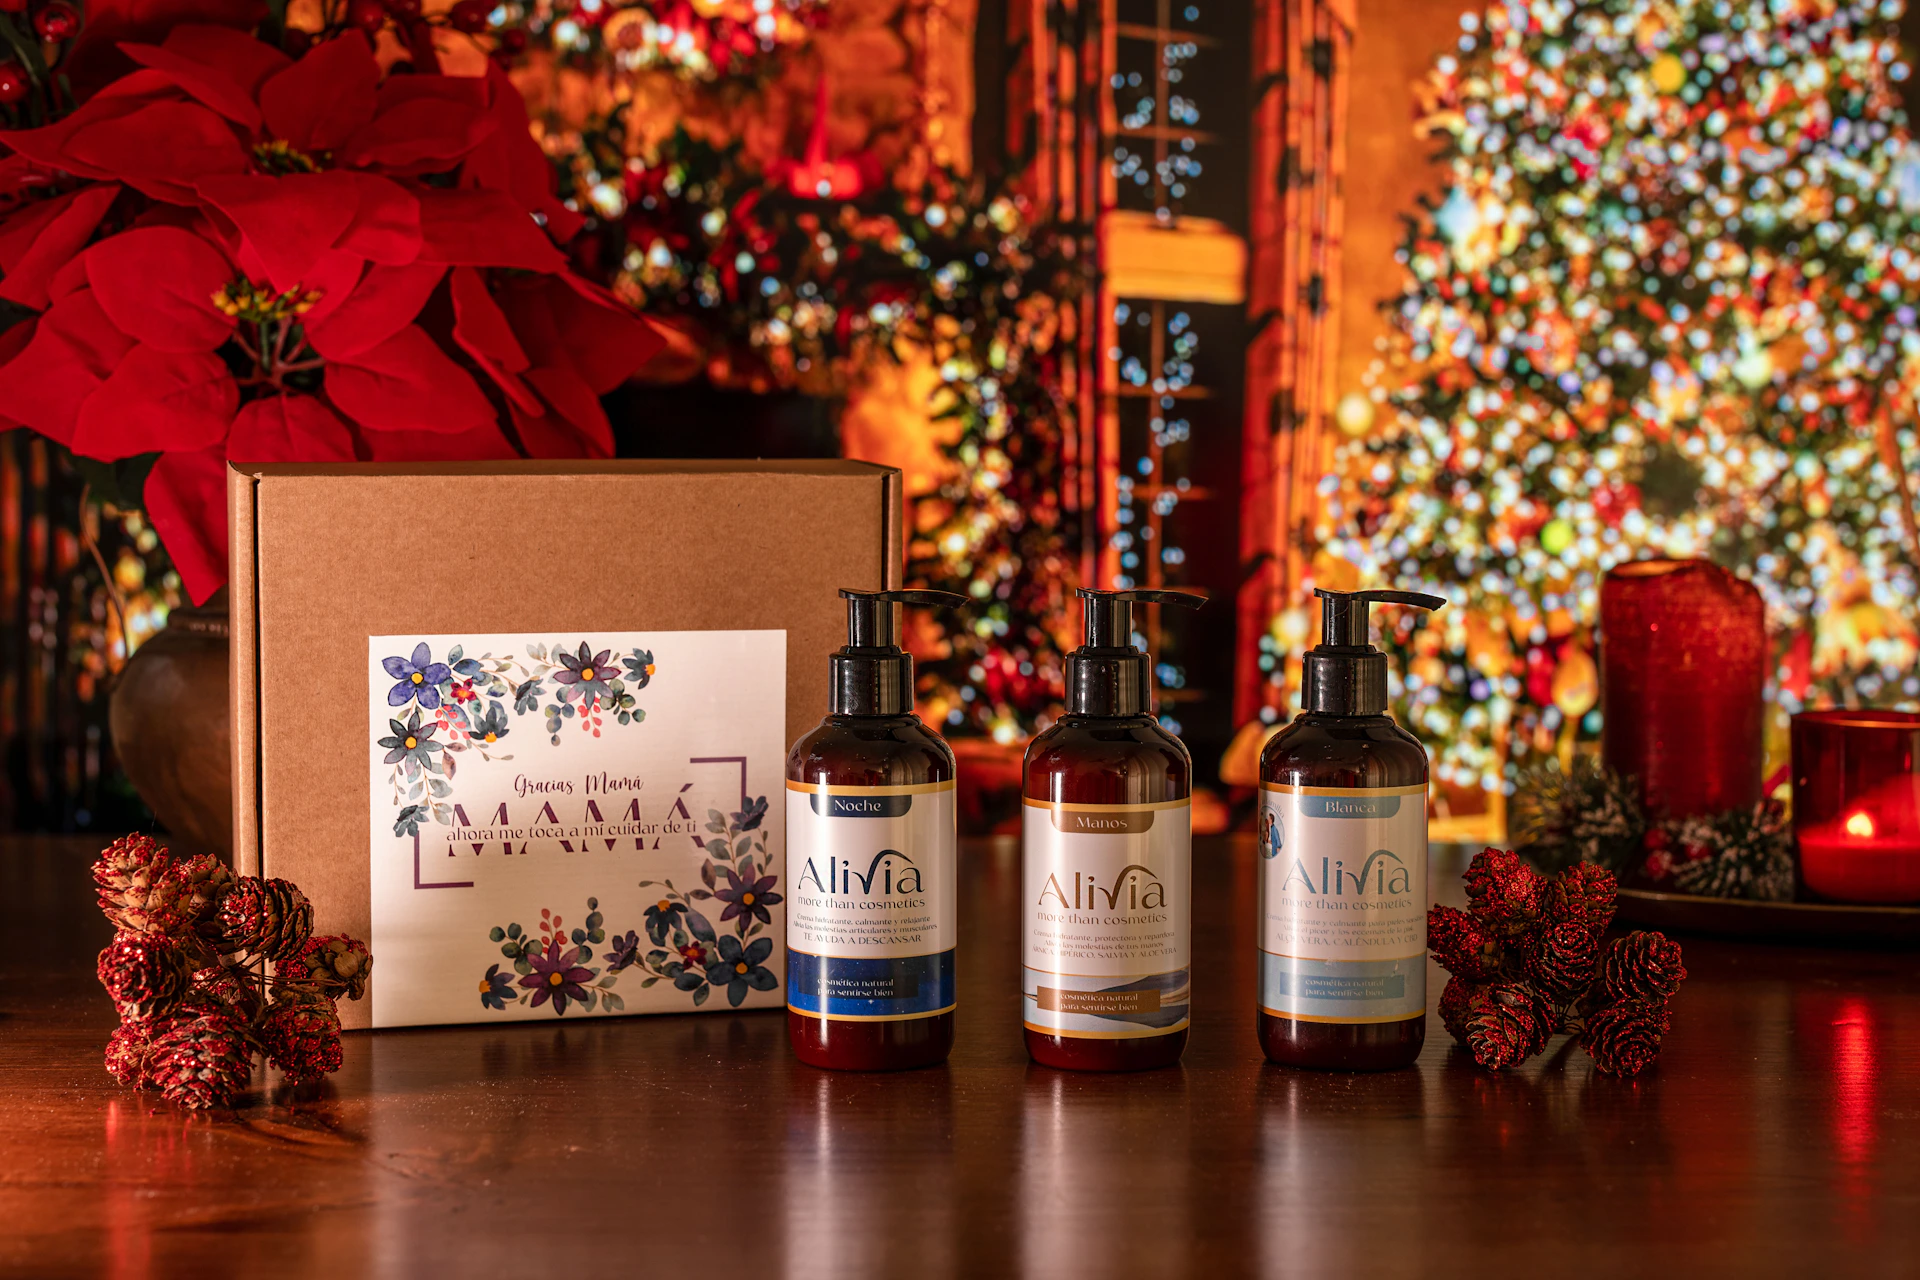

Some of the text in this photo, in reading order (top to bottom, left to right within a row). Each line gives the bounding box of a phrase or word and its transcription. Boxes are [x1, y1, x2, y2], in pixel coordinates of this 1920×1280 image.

[514, 771, 644, 798] Gracias Mamá
[834, 799, 882, 812] Noche
[1325, 801, 1376, 814] Blanca
[1076, 816, 1128, 829] Manos
[446, 820, 697, 841] ahora me toca a mí cuidar de ti
[798, 849, 925, 895] Alivia
[1282, 849, 1412, 895] Alivia
[1038, 864, 1168, 910] Alivia
[798, 896, 926, 910] more than cosmetics
[1282, 897, 1412, 911] more than cosmetics
[855, 918, 892, 926] calmante
[1037, 911, 1168, 926] more than cosmetics
[848, 926, 892, 935] articulares
[1309, 927, 1330, 936] picor
[804, 932, 922, 945] TE AYUDA A DESCANSAR
[1094, 934, 1137, 943] protectora
[1333, 936, 1395, 947] CALÉNDULA
[1075, 943, 1113, 951] molestias
[1114, 943, 1125, 951] de
[1140, 941, 1164, 950] manos
[1097, 951, 1129, 959] SALVIA
[1130, 951, 1137, 959] Y
[1138, 949, 1160, 958] ALOE
[1160, 947, 1177, 956] VERA
[861, 978, 894, 987] natural
[1305, 978, 1384, 988] cosmética natural
[837, 988, 872, 997] sentirse
[873, 988, 894, 997] bien
[1060, 993, 1138, 1002] cosmética natural
[1060, 1003, 1138, 1012] para sentirse bien
